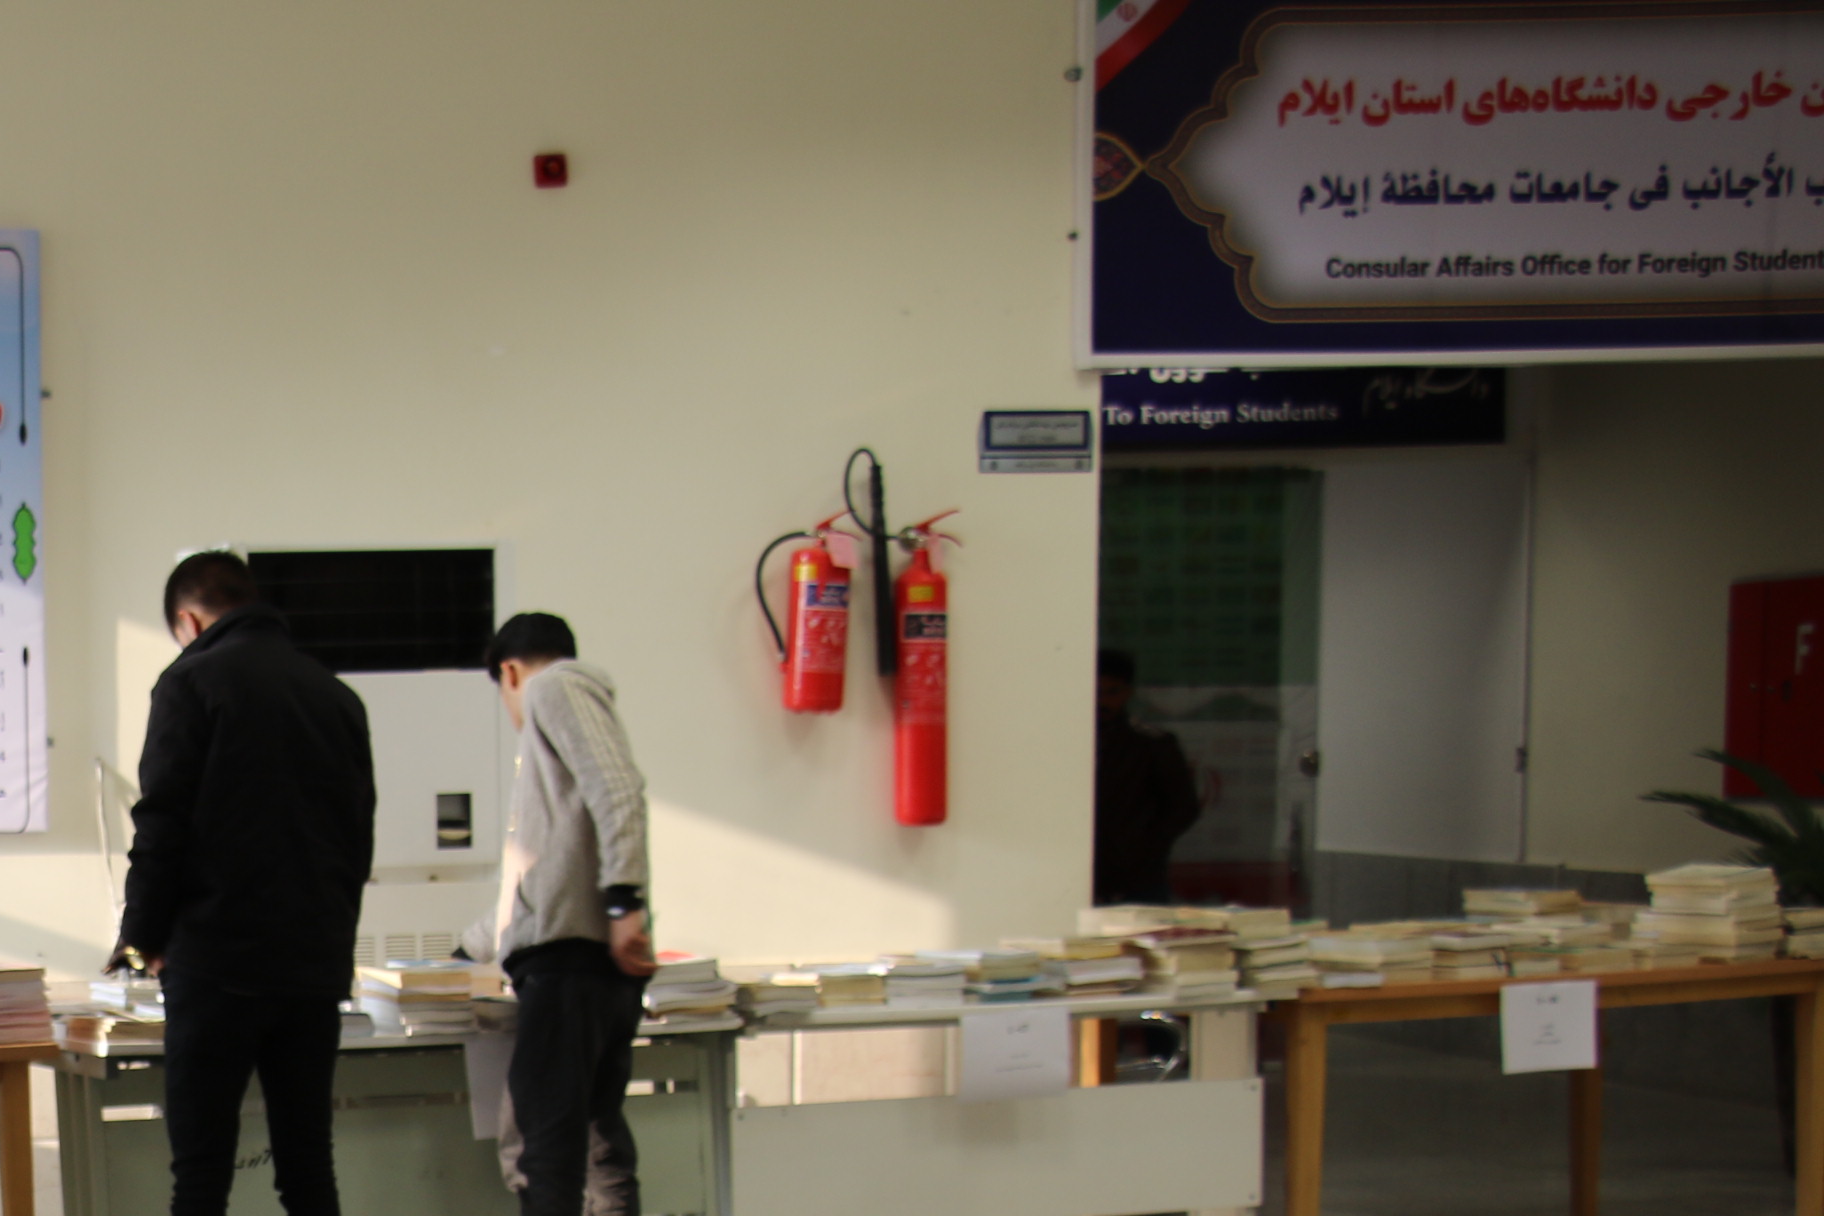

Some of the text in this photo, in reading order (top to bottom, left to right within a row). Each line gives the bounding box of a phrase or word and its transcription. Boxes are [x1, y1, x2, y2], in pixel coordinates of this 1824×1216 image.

[1277, 77, 1355, 128] ایلام
[1361, 78, 1455, 128] استان
[1665, 69, 1793, 121] خارجی
[1509, 168, 1620, 211] جامعات
[1682, 152, 1794, 209] الأجانب
[1326, 256, 1430, 279] Consular
[1436, 254, 1514, 278] Affairs
[1521, 253, 1591, 277] Office
[1598, 252, 1632, 275] for
[1638, 250, 1727, 280] Foreign
[1105, 401, 1340, 431] To Foreign Students
